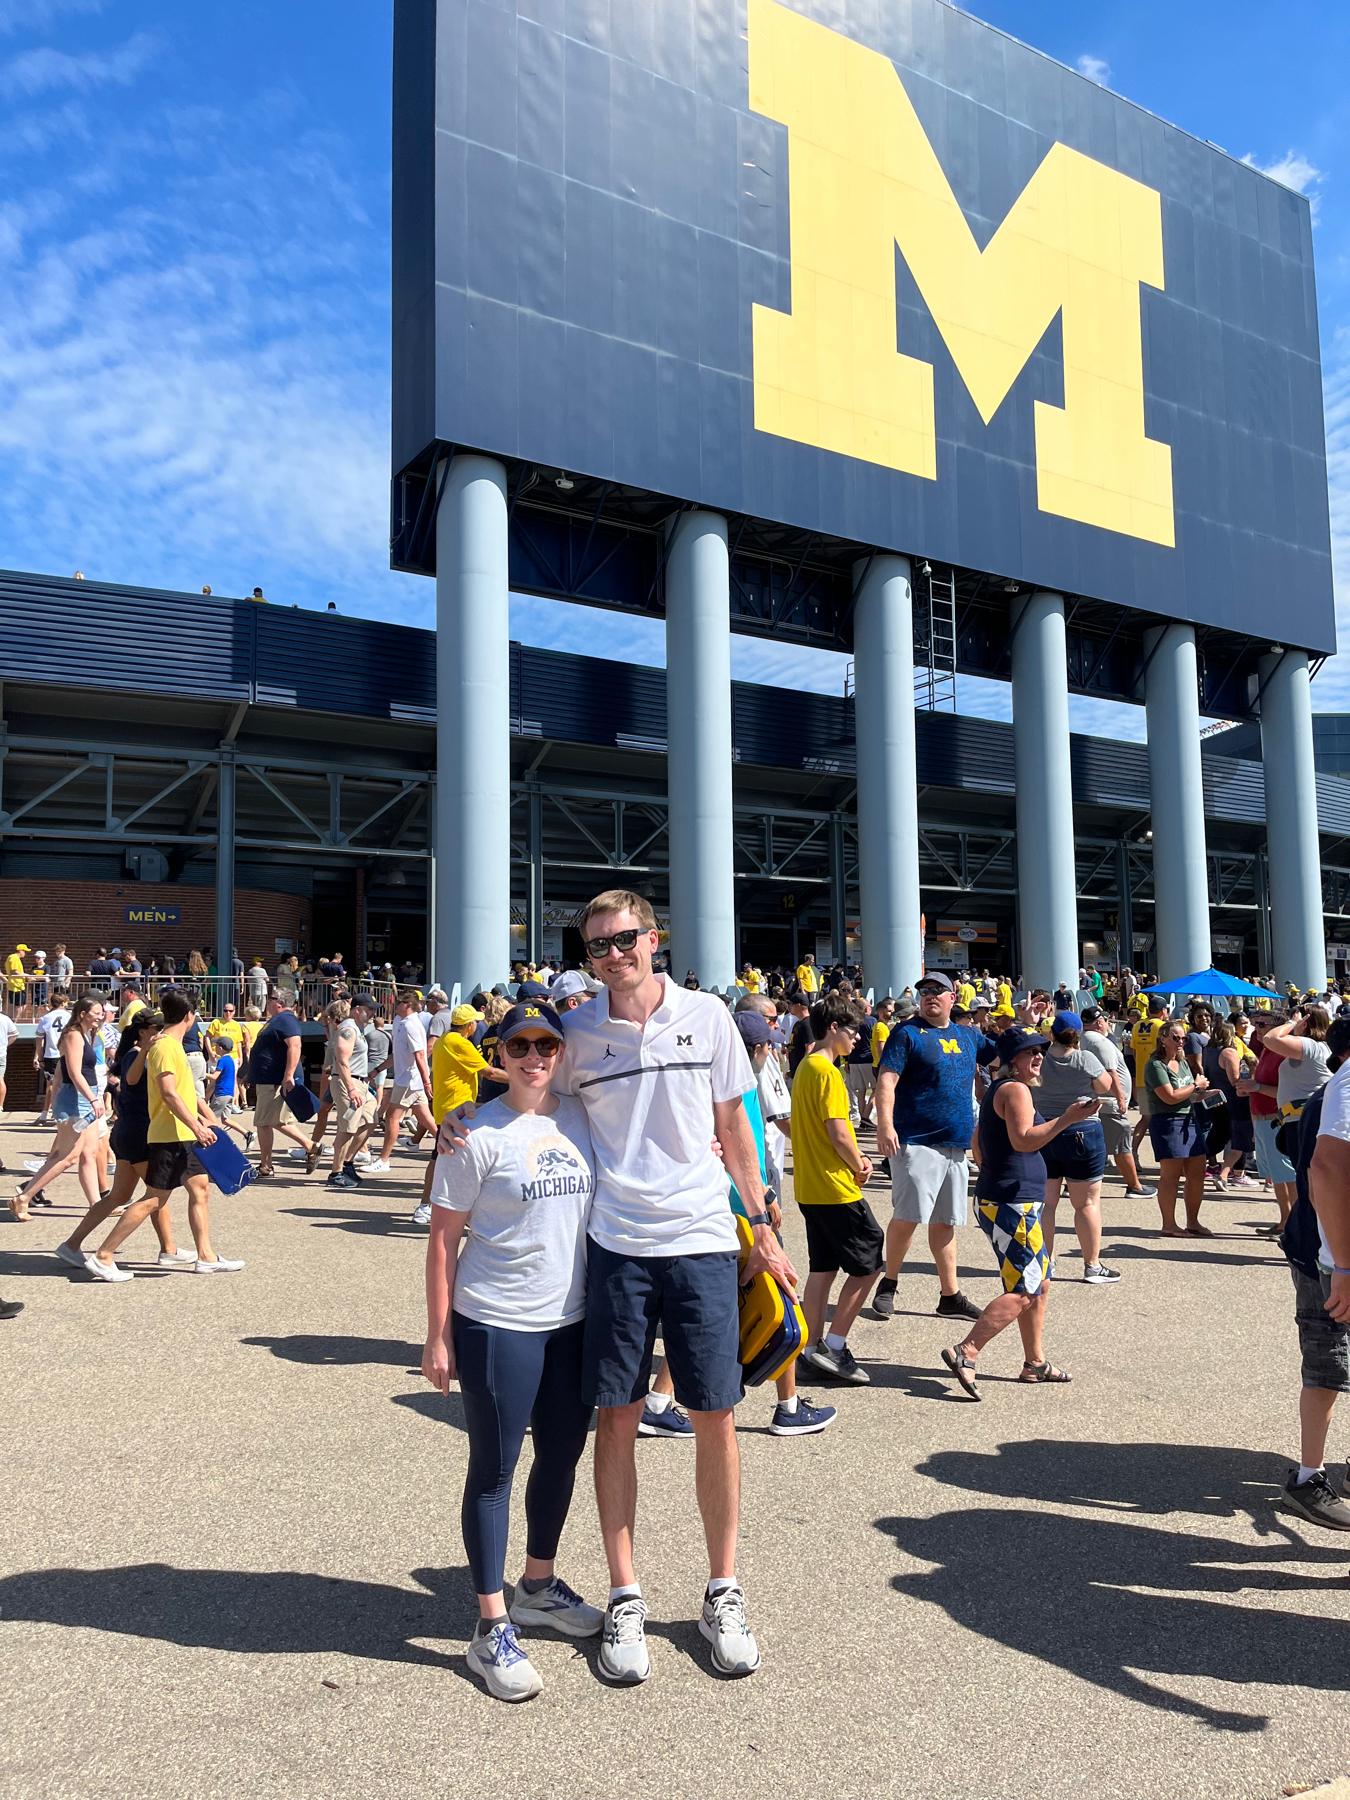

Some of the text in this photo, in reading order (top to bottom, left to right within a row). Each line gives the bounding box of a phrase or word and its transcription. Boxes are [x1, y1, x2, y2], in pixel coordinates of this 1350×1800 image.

[748, 0, 1175, 548] M
[782, 893, 796, 909] 12
[129, 911, 166, 922] MEN
[524, 1007, 541, 1018] M
[52, 1015, 63, 1032] 4
[676, 1034, 693, 1046] M
[938, 1038, 962, 1054] M
[520, 1174, 593, 1202] MICHIGAN
